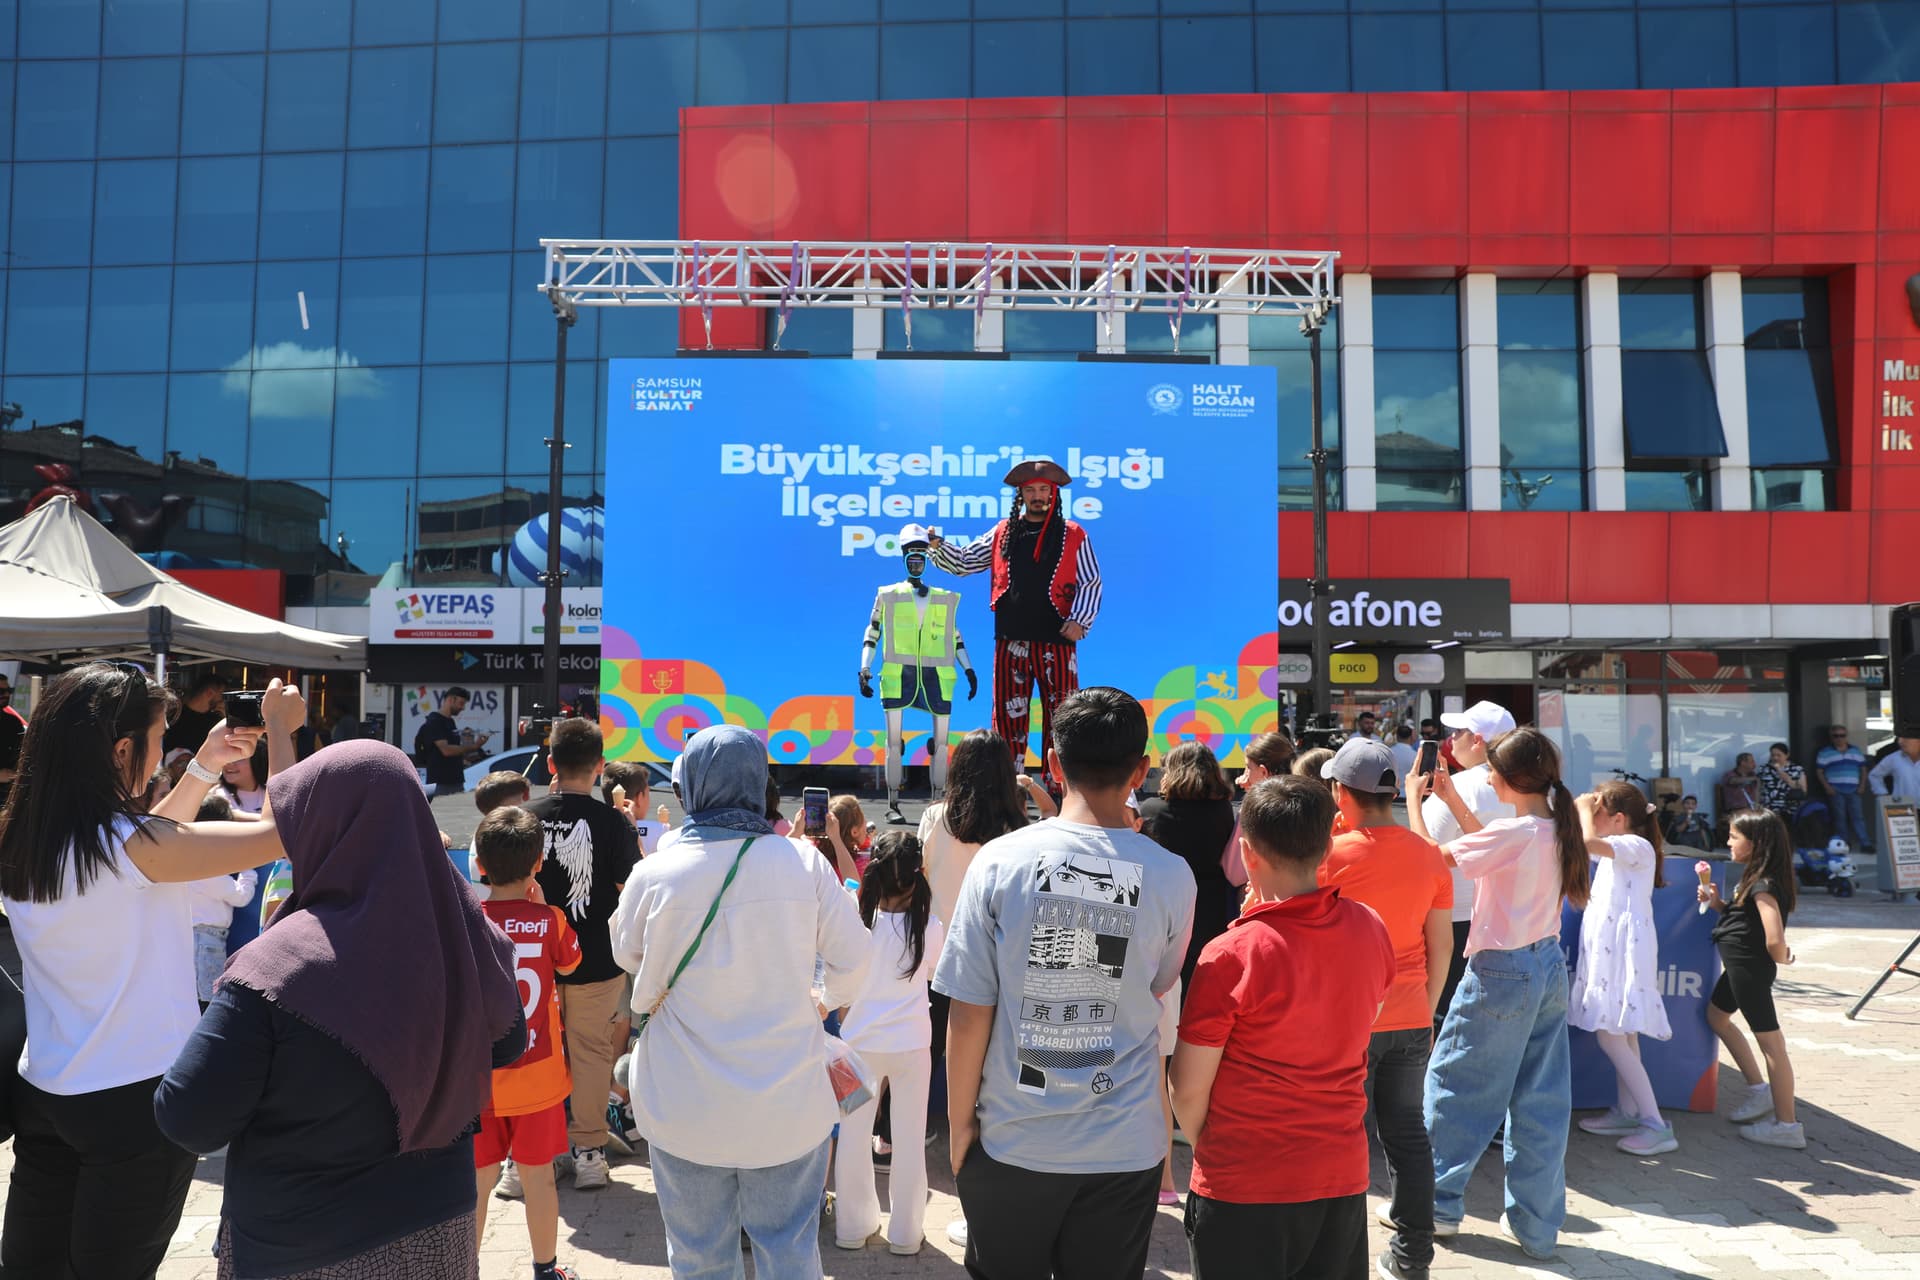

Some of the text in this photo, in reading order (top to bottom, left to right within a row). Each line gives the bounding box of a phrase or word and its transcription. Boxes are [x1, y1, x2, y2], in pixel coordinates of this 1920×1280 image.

[636, 377, 702, 388] SAMSUN
[635, 400, 694, 411] SANAT
[720, 443, 1164, 490] Büyükşehir'i Işığı
[421, 594, 495, 618] YEPAŞ
[483, 652, 525, 670] Türk
[1339, 664, 1366, 673] POCO
[1032, 896, 1137, 937] NEW KYOTO
[504, 918, 548, 937] Enerji
[1031, 1001, 1106, 1022] 京都市
[1103, 1025, 1112, 1033] W
[1076, 1035, 1113, 1049] KYOTO
